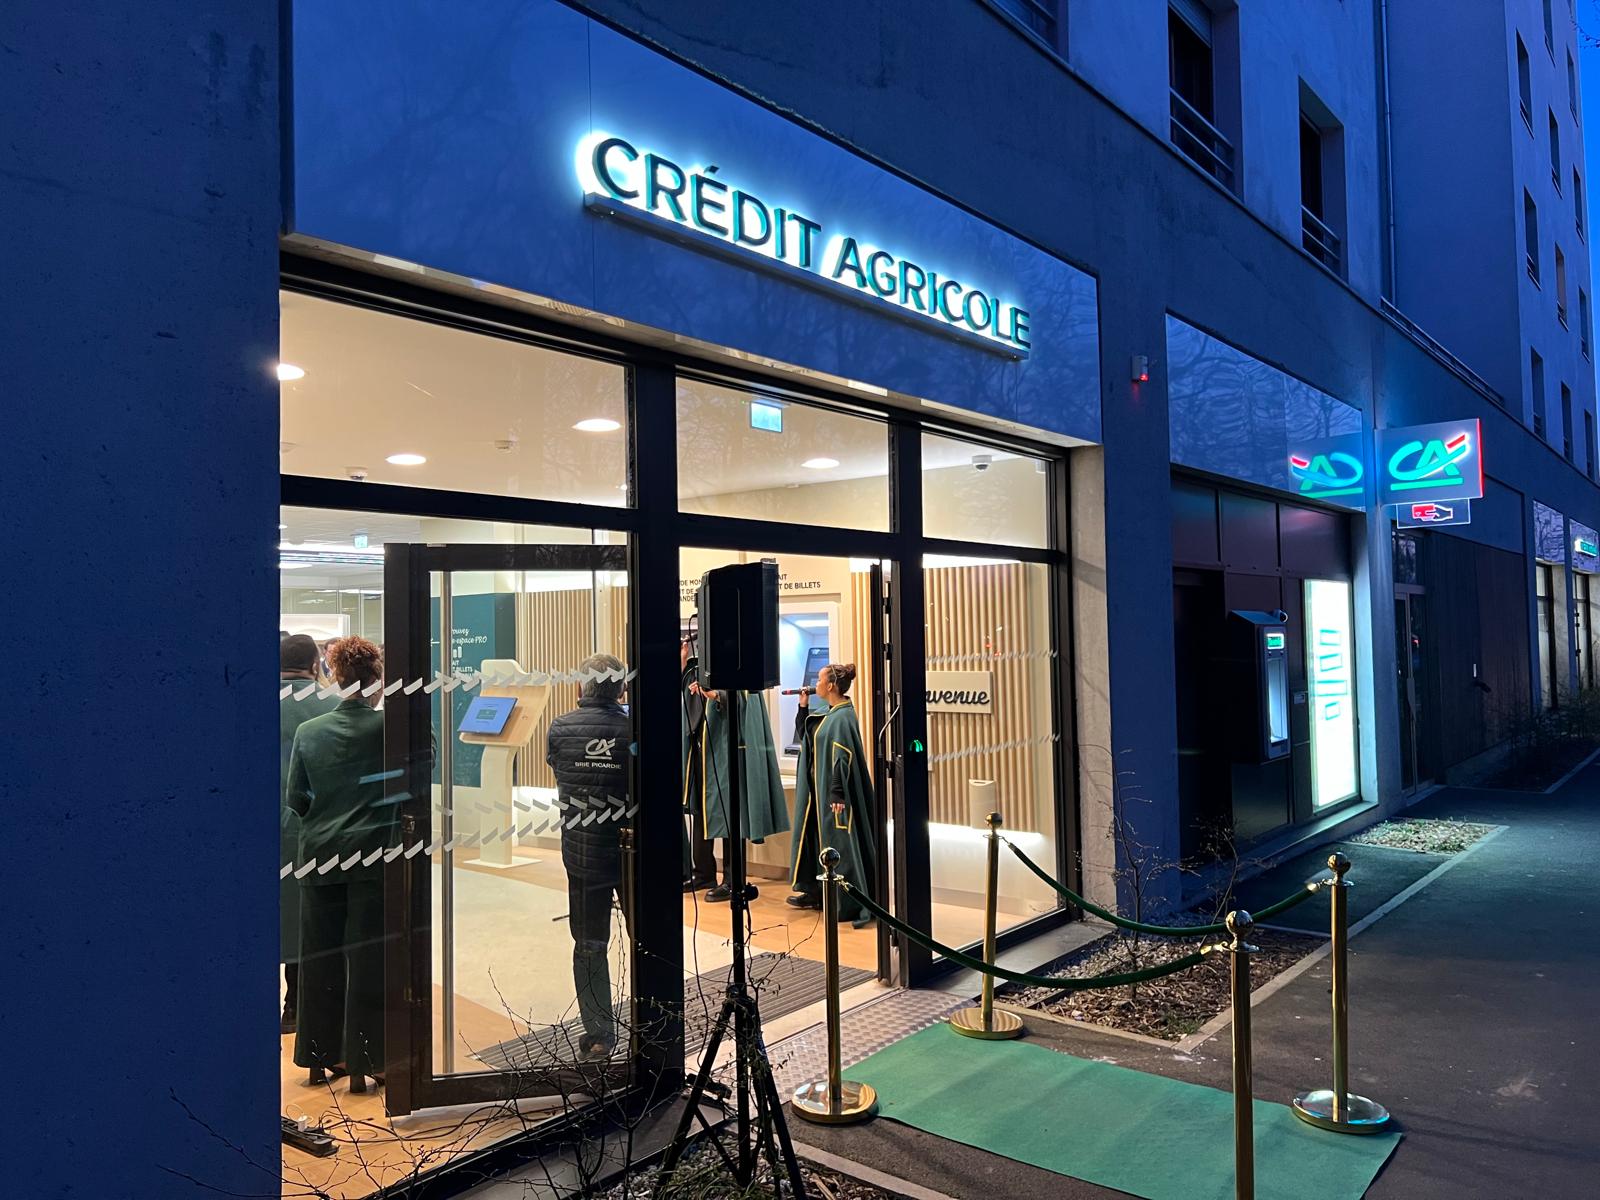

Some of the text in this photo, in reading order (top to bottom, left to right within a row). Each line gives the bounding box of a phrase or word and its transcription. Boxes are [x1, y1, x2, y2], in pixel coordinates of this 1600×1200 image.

[592, 138, 1031, 349] CRÉDIT AGRICOLE
[794, 581, 821, 589] BILLETS
[474, 635, 488, 644] PRO
